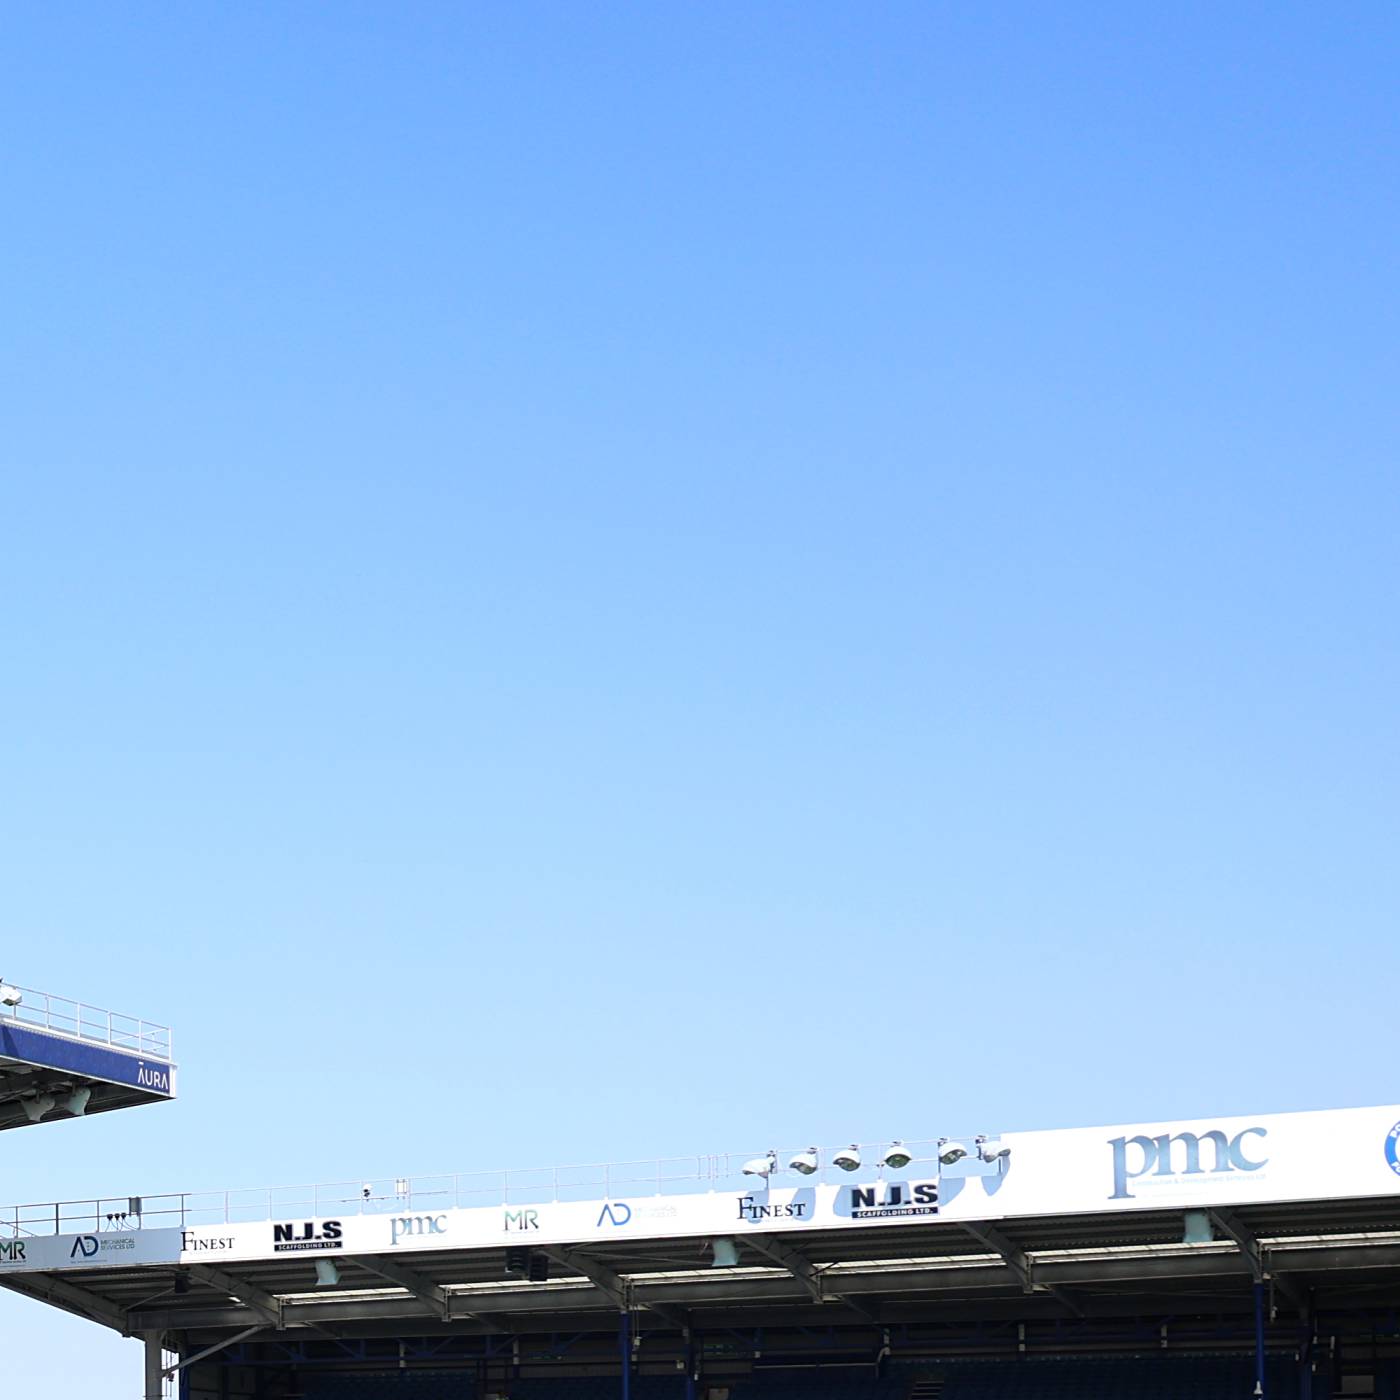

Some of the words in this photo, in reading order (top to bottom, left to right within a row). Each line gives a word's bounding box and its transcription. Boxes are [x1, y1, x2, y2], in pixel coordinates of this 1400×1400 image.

[1106, 1126, 1269, 1199] pmc
[850, 1184, 939, 1208] N.J.S
[502, 1209, 539, 1232] MR
[856, 1208, 913, 1218] SCAFFOLDING
[273, 1220, 343, 1243] N.J.S
[389, 1213, 448, 1246] pmc
[278, 1242, 322, 1250] SCAFFOLDING
